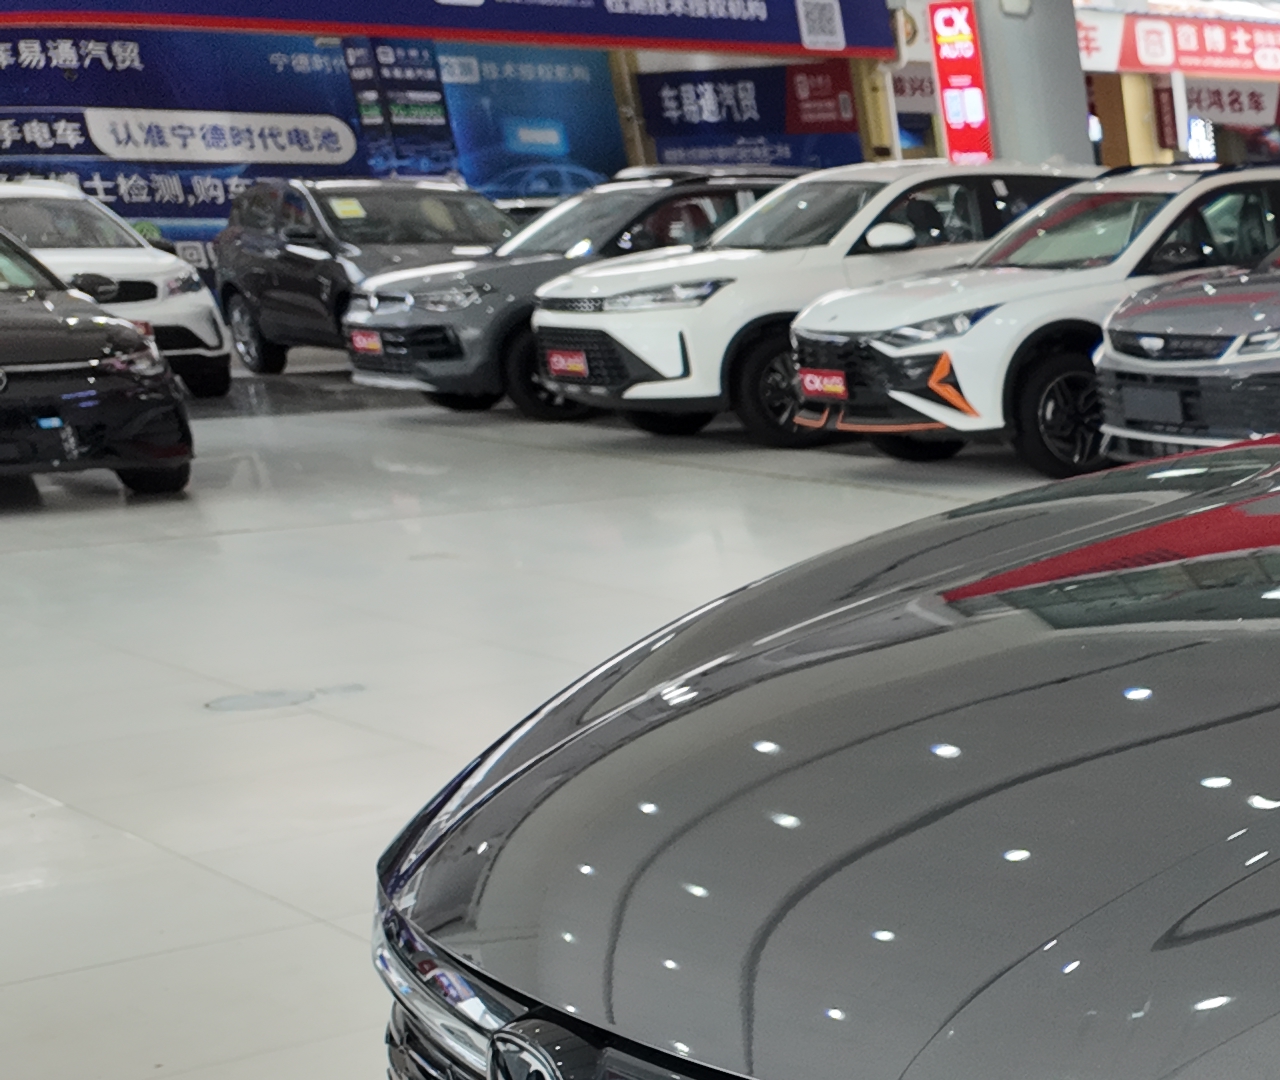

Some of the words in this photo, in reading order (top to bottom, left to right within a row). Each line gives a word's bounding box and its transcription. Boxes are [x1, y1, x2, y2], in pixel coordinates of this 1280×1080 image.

[933, 6, 972, 36] CX
[109, 121, 344, 153] 认准宁德时代电池
